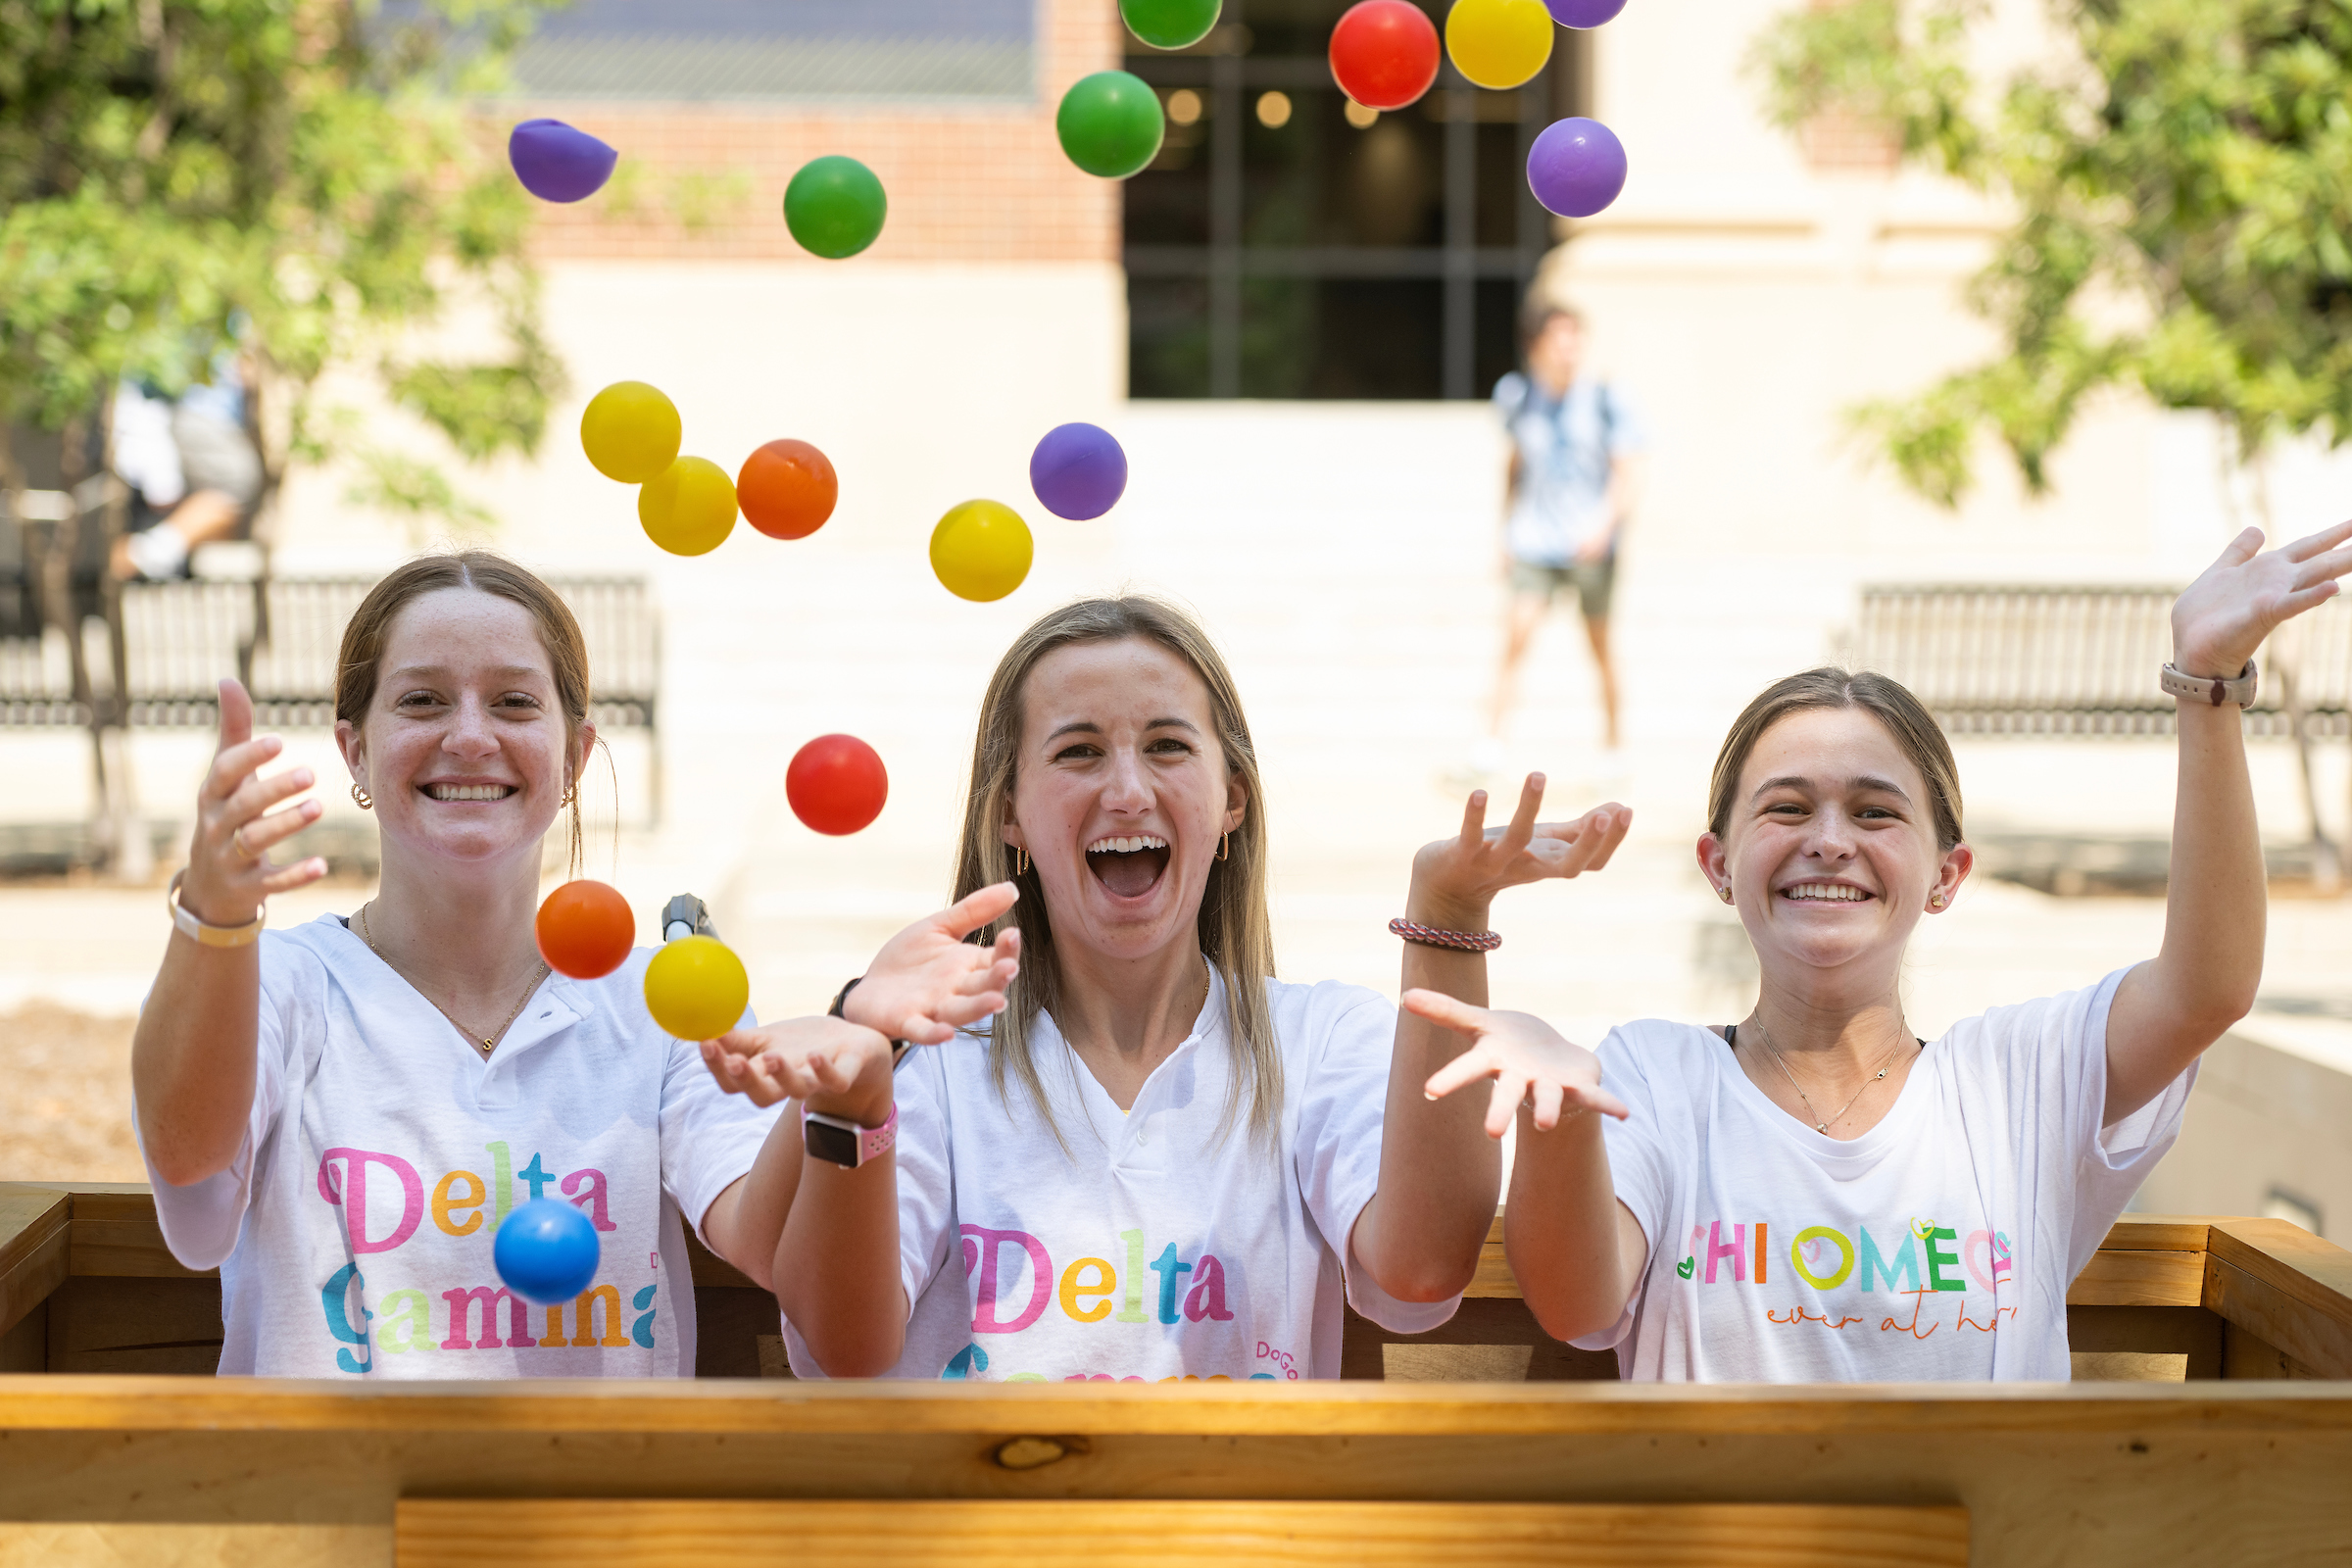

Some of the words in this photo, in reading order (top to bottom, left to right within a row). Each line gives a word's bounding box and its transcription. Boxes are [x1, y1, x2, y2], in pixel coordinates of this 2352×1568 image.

[318, 1141, 617, 1254] Delta
[959, 1223, 1235, 1334] Delta
[1881, 1284, 1939, 1340] at
